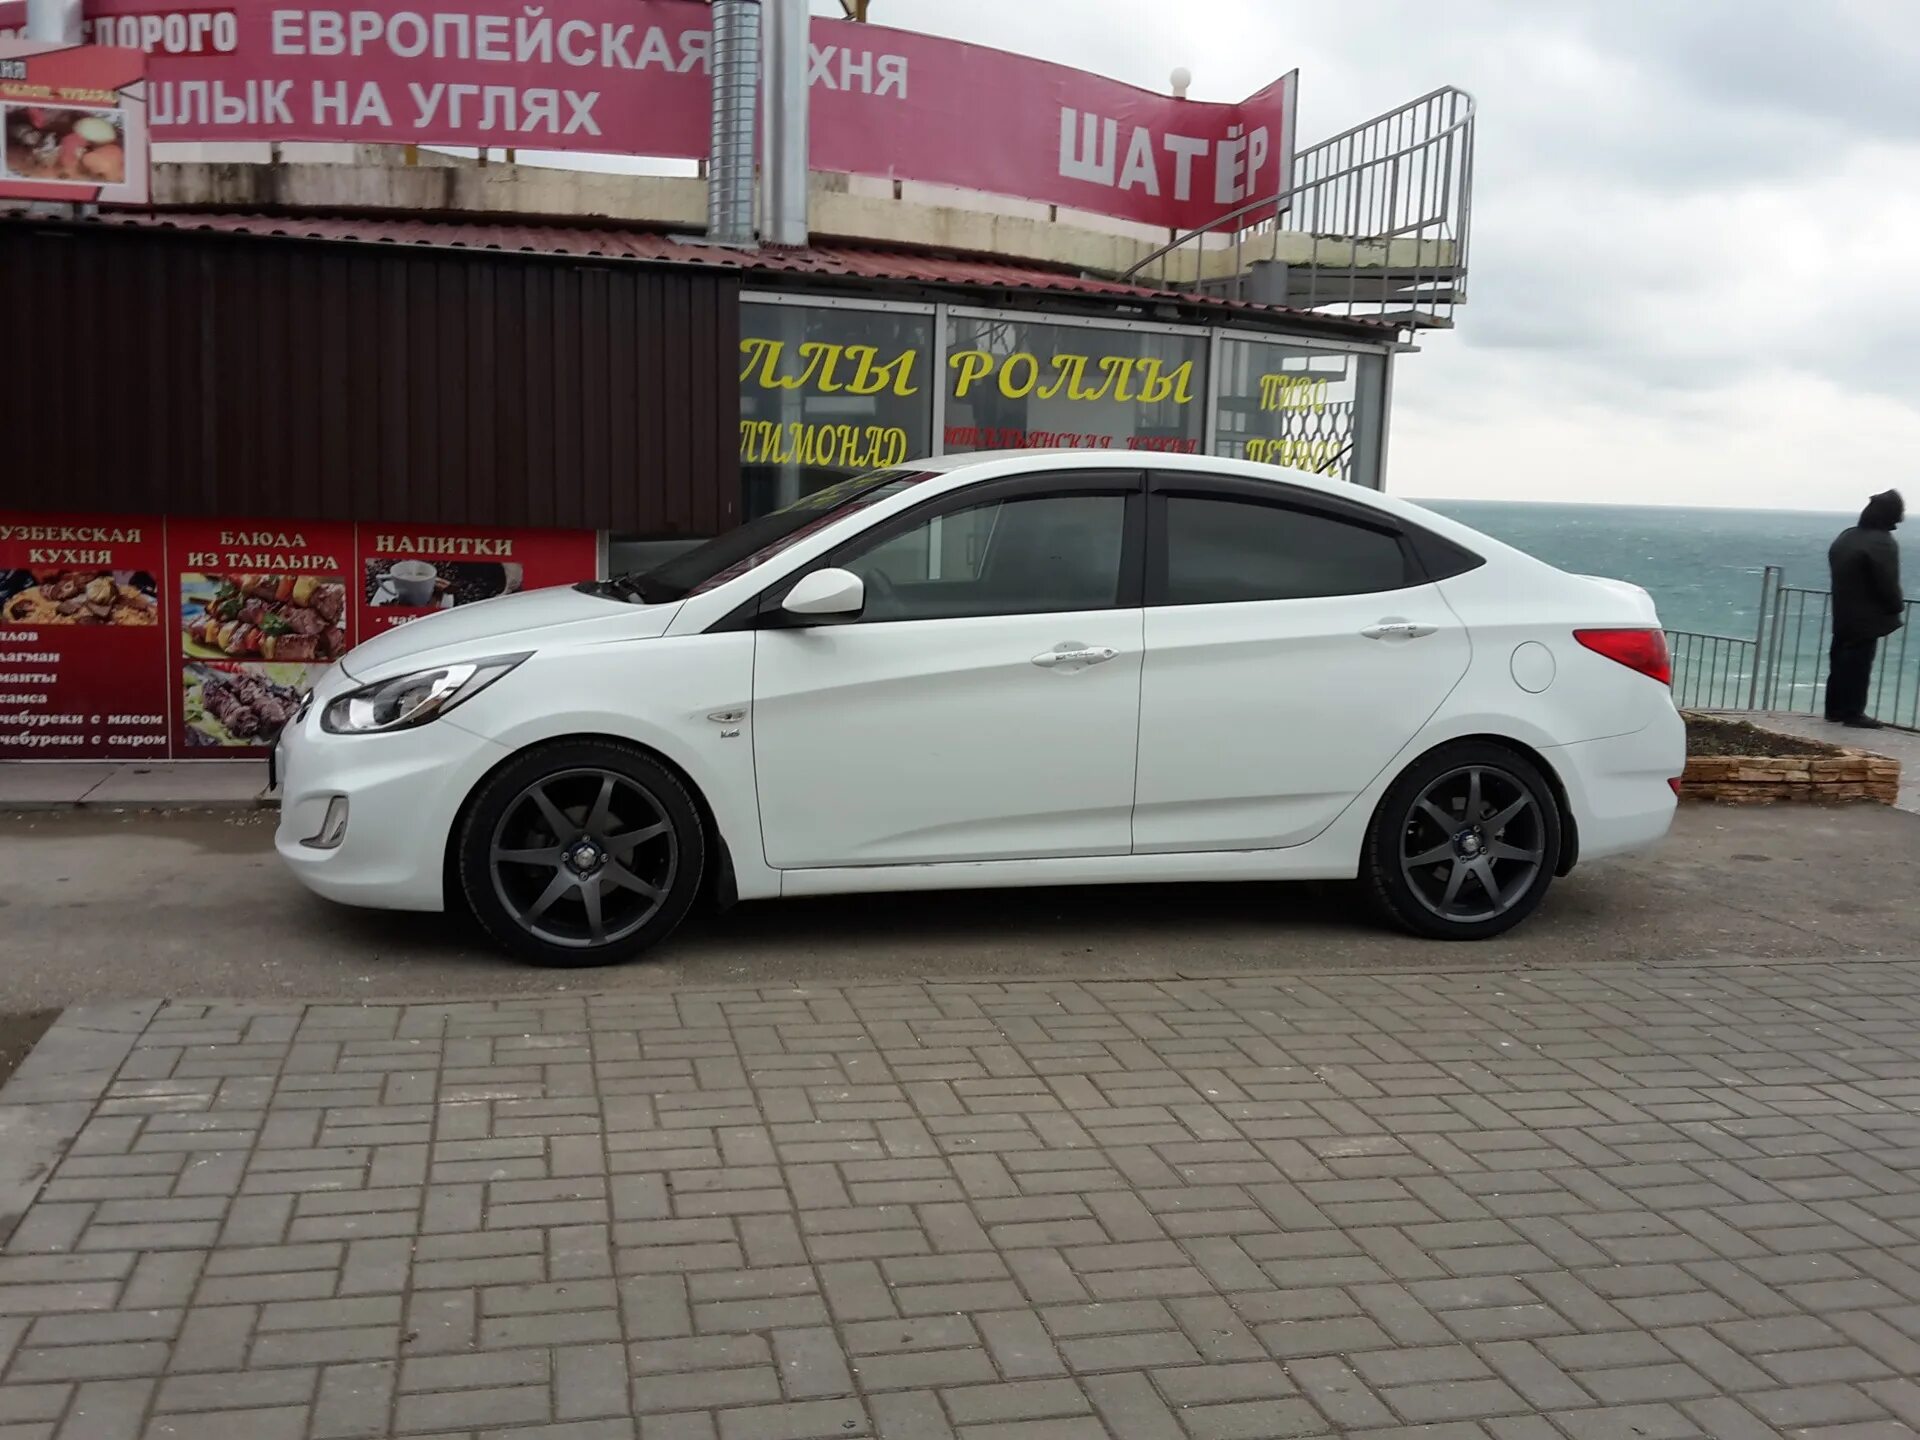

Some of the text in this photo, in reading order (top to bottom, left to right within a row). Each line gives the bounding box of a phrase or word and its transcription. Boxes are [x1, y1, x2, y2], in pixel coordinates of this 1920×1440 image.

[272, 6, 712, 75] ЕВРОПЕЙСКАЯ
[757, 37, 908, 98] ХНЯ
[312, 80, 392, 126] НА
[409, 83, 601, 136] УГЛЯХ
[1059, 107, 1268, 204] ШАТЁР
[949, 350, 1193, 404] РОЛЛЫ
[1260, 374, 1327, 413] ПИВО
[740, 420, 907, 468] ЛИМОНАД
[0, 526, 141, 543] УЗБЕКСКАЯ
[220, 531, 307, 547] БЛЮДА
[376, 535, 513, 556] НАПИТКИ
[29, 549, 112, 564] КУХНЯ
[188, 552, 339, 570] ИЗ ТАНДЫРА
[0, 694, 48, 703] самса
[0, 710, 163, 726] чебуреки с мясом
[0, 731, 166, 747] чебуреки с сыром
